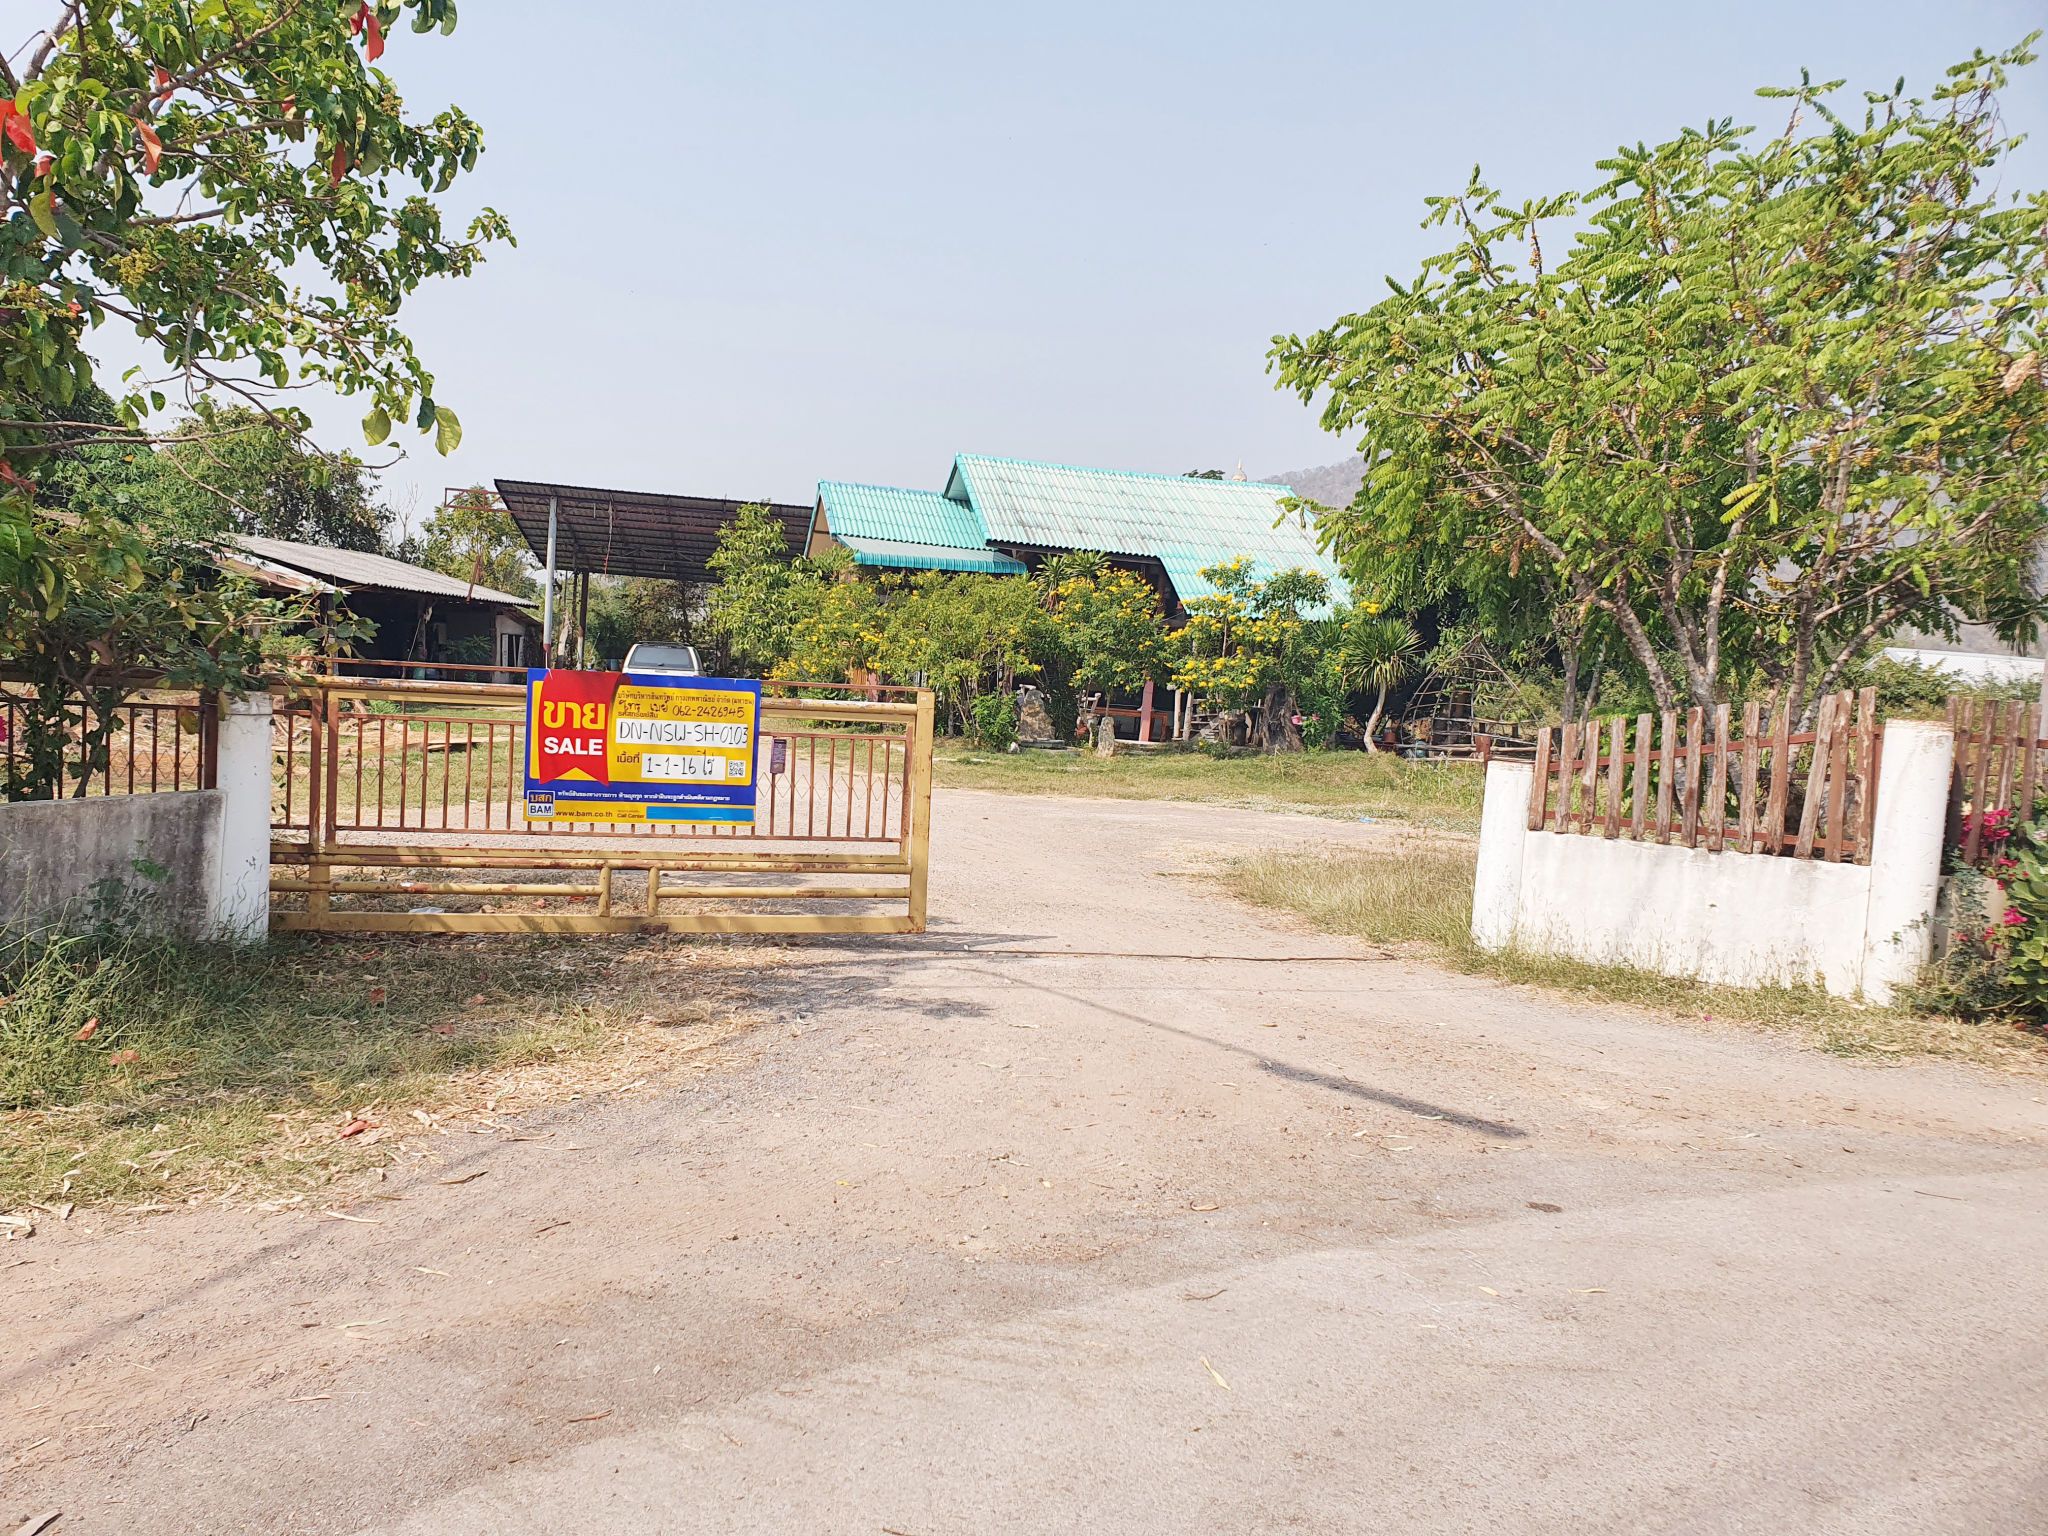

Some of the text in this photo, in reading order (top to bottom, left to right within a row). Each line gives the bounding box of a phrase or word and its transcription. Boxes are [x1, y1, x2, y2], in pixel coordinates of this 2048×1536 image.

[543, 701, 606, 730] ขาย
[672, 704, 745, 719] 062-2426945
[619, 722, 748, 745] DN-NSW-SH-0103
[544, 736, 604, 756] SALE
[616, 751, 641, 764] เนื้อที่
[646, 756, 697, 775] 1-1-16
[529, 793, 553, 803] บสก
[529, 805, 552, 814] BAM
[555, 810, 613, 818] www.bam.co.th
